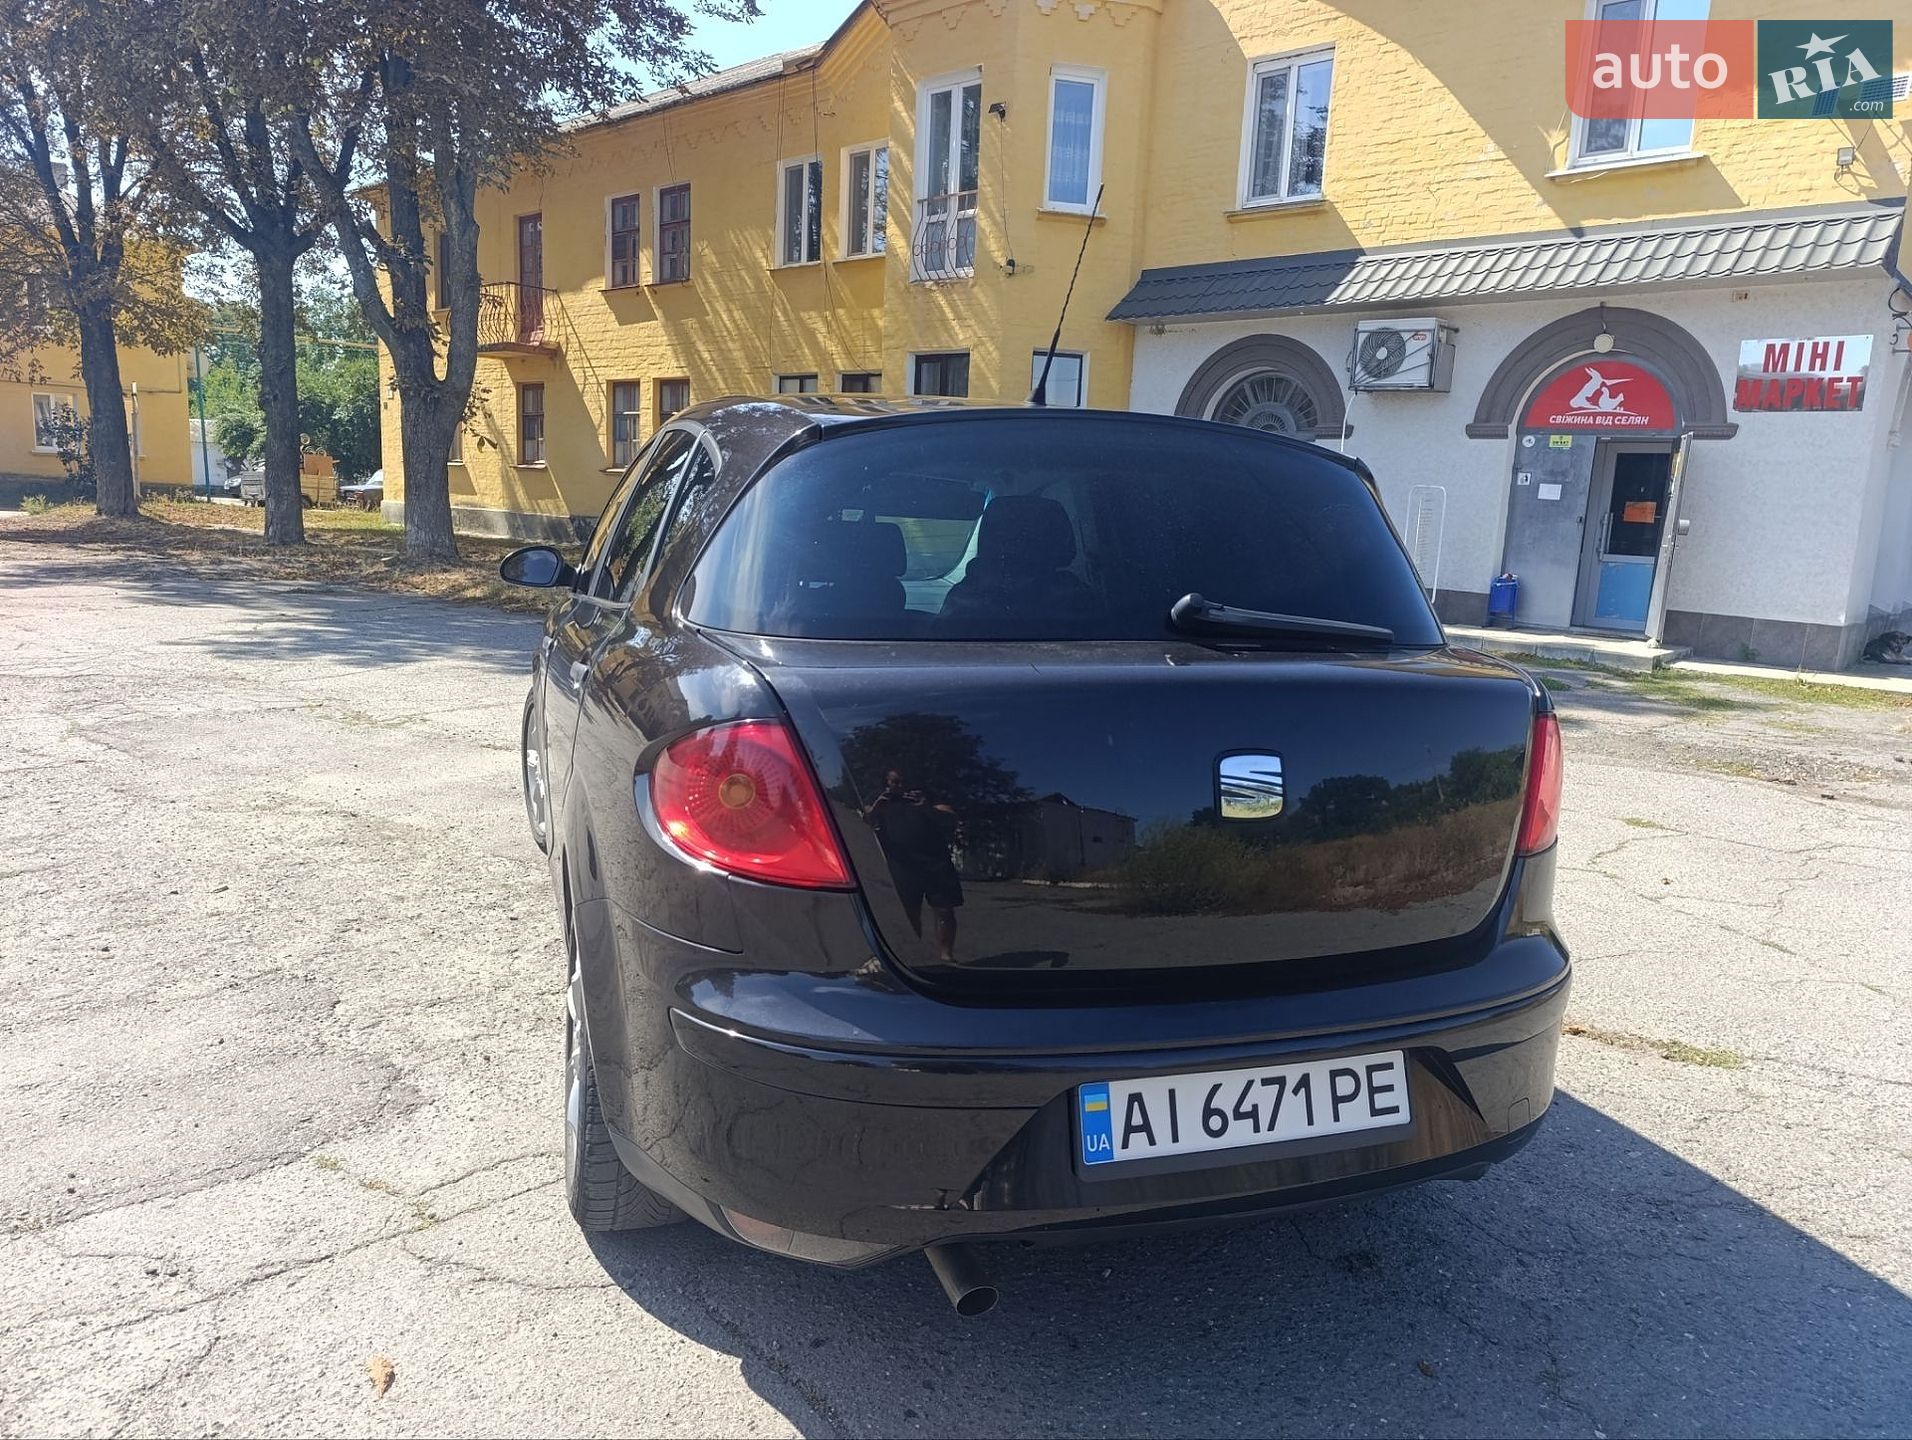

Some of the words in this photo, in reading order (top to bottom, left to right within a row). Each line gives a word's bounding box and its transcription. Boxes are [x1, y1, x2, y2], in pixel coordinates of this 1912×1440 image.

[1762, 341, 1845, 373] МІНІ
[1733, 376, 1864, 410] МАРКЕТ
[1548, 415, 1593, 424] СВІЖИНА
[1595, 416, 1612, 425] ВІД
[1614, 416, 1650, 425] СЕЛЯН
[1086, 1133, 1111, 1152] UA
